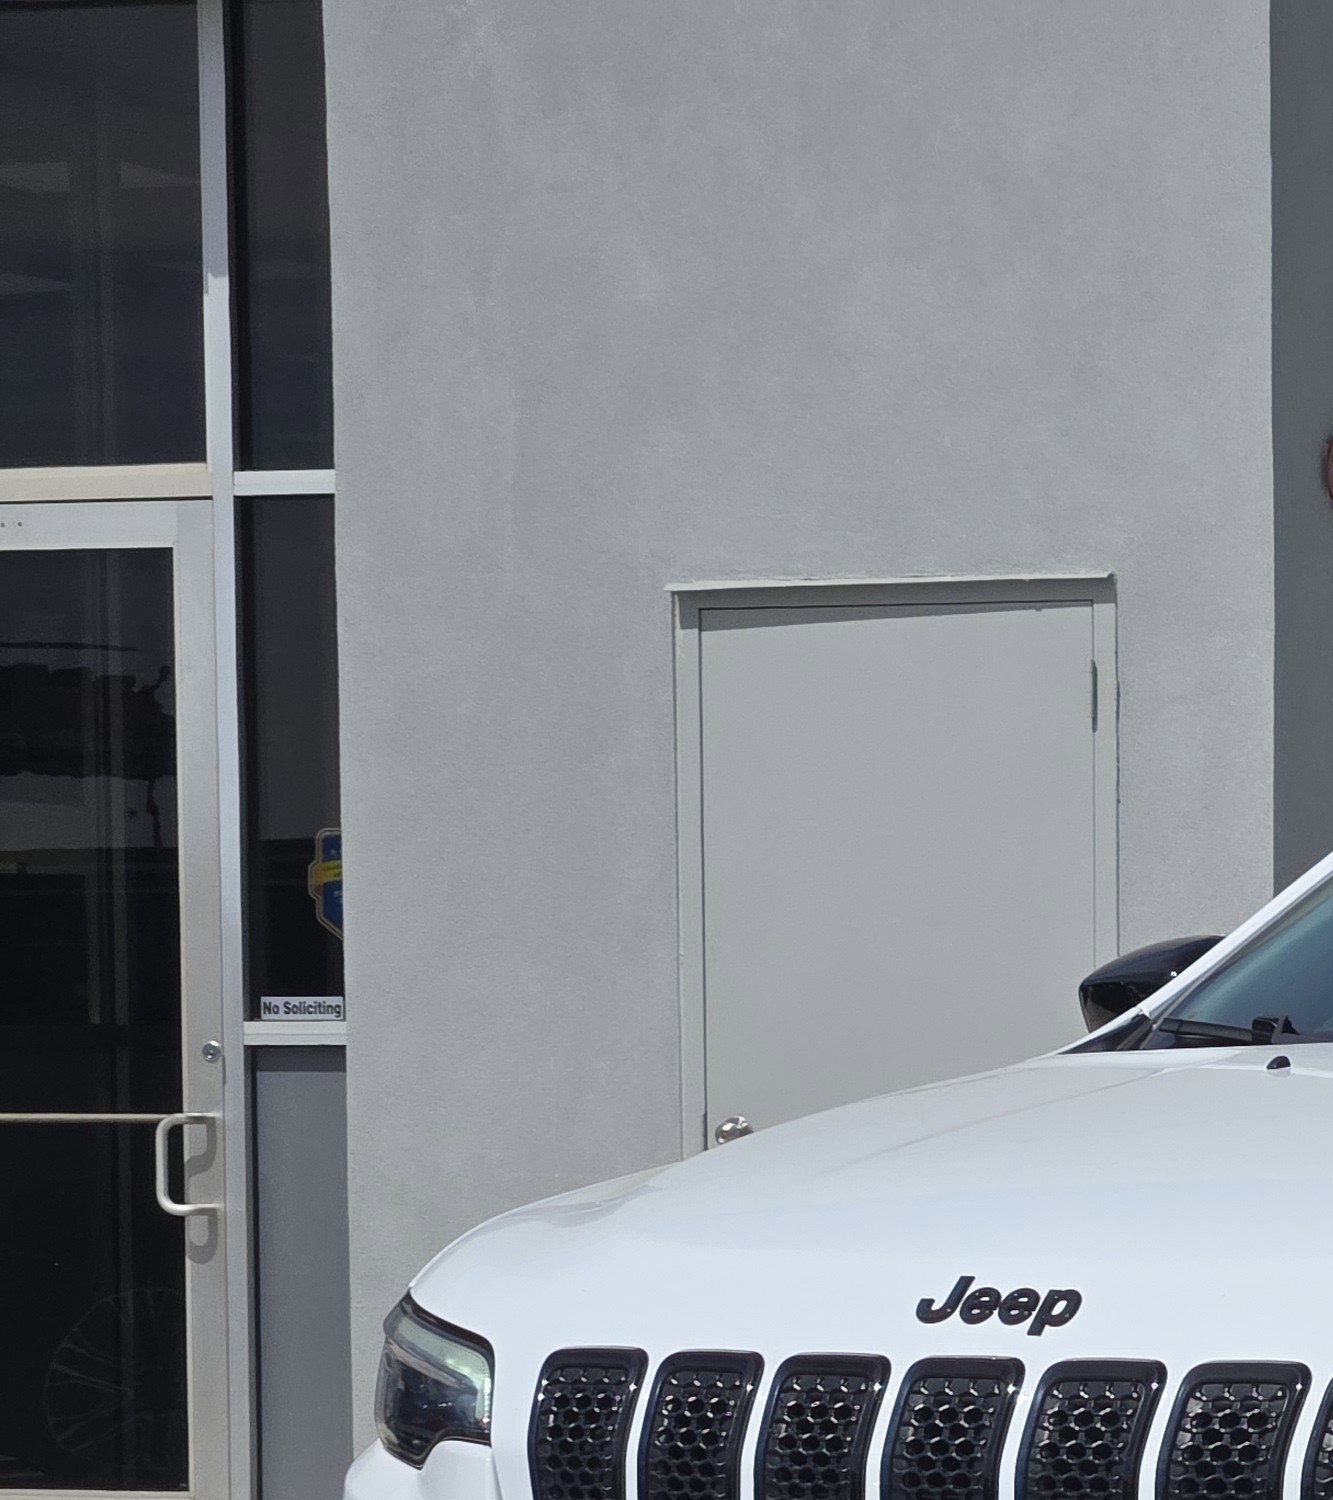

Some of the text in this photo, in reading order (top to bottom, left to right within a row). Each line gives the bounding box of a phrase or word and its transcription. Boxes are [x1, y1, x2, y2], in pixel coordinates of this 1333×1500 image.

[263, 1001, 342, 1018] No Soliciting
[915, 1275, 1083, 1337] Jeep
